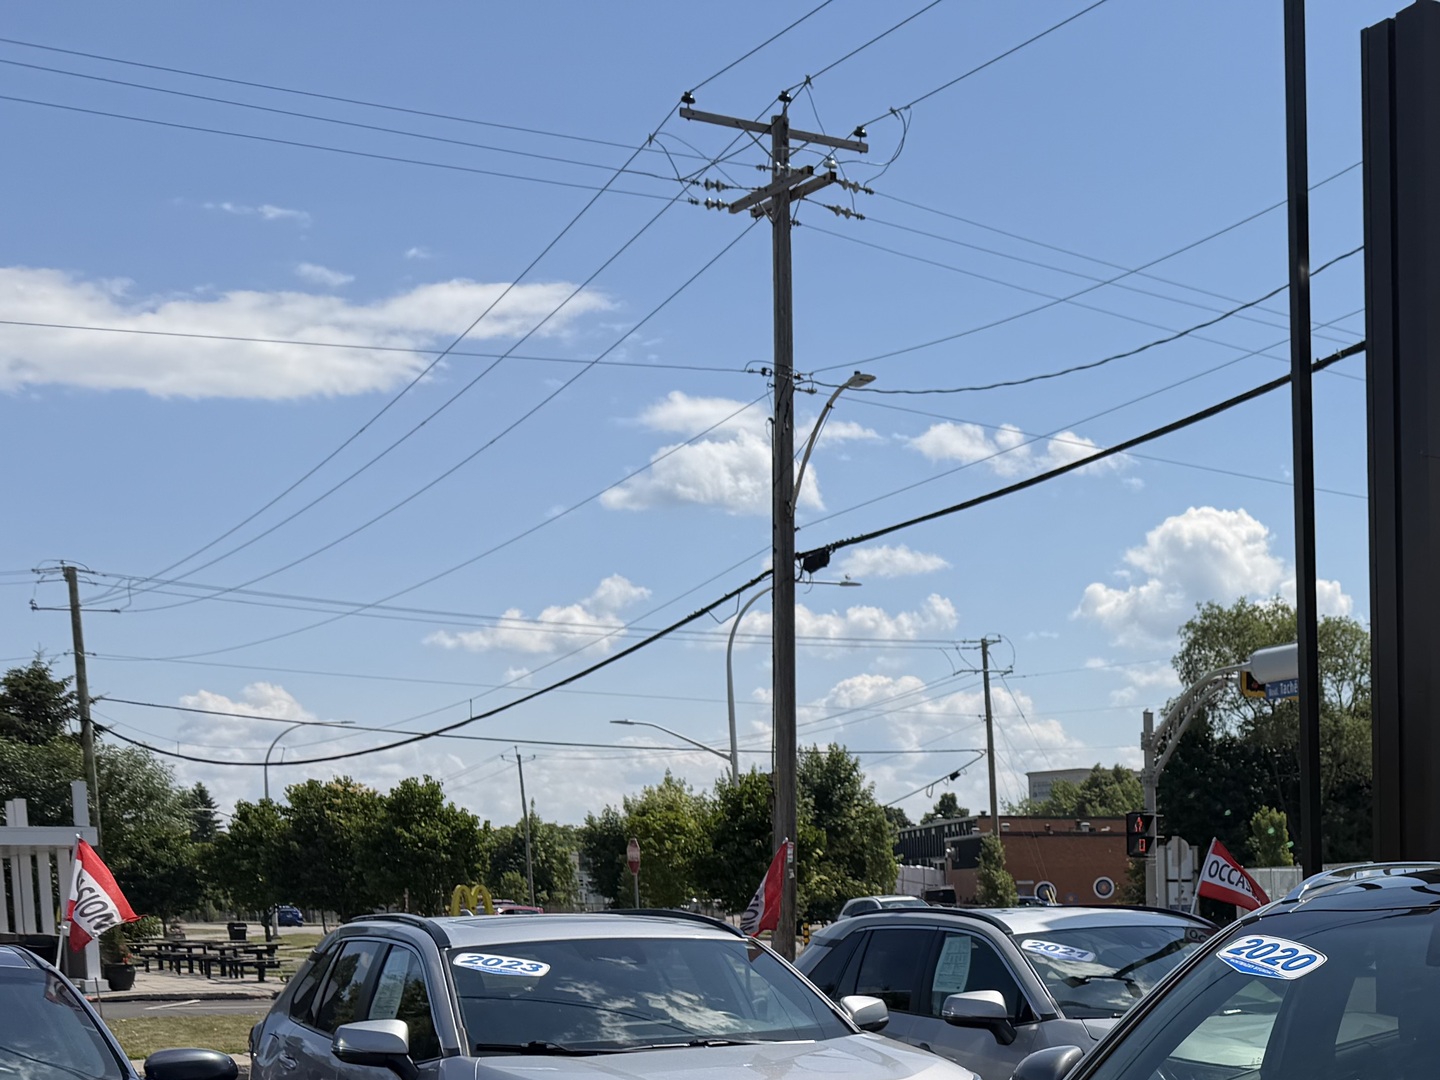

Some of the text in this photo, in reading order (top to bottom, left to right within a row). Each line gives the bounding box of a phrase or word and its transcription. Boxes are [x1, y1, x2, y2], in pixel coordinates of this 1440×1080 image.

[1027, 941, 1089, 959] 2021
[1226, 938, 1318, 971] 2020
[460, 955, 543, 973] 2023
